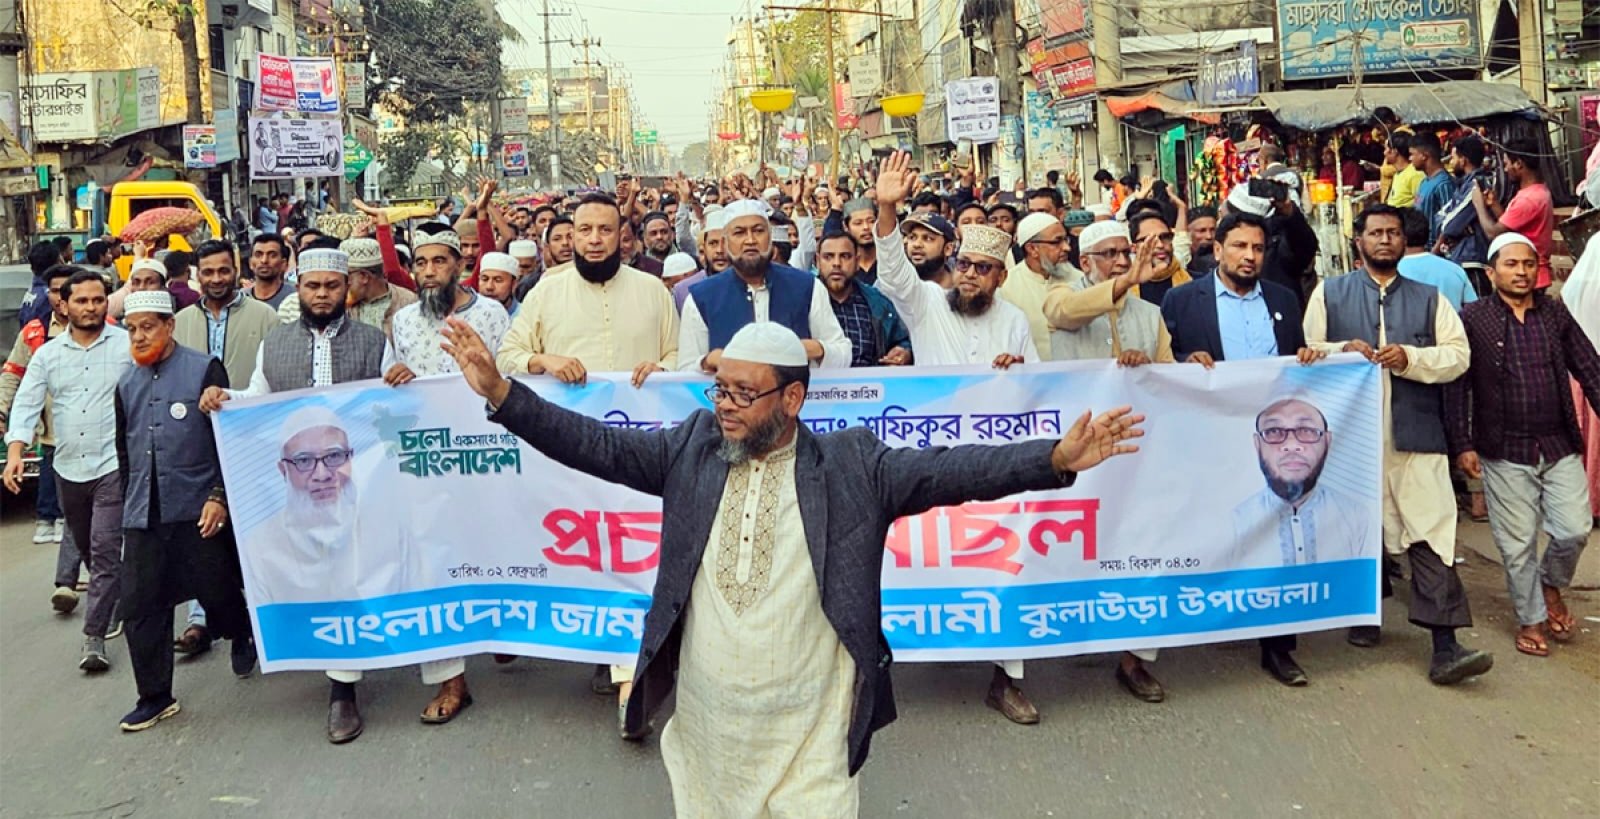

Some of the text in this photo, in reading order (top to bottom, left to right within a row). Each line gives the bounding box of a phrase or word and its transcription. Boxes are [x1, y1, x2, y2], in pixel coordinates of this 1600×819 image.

[970, 410, 1062, 441] রহমান
[398, 428, 451, 451] চলো
[452, 434, 497, 448] একসাথে
[398, 448, 522, 478] বাংলাদেশ
[487, 566, 505, 579] ০২
[1128, 555, 1162, 571] বিকাল
[1164, 556, 1200, 569] ০৪.৩০
[311, 598, 538, 646] বাংলাদেশ
[1018, 592, 1168, 639] কুলাউড়া
